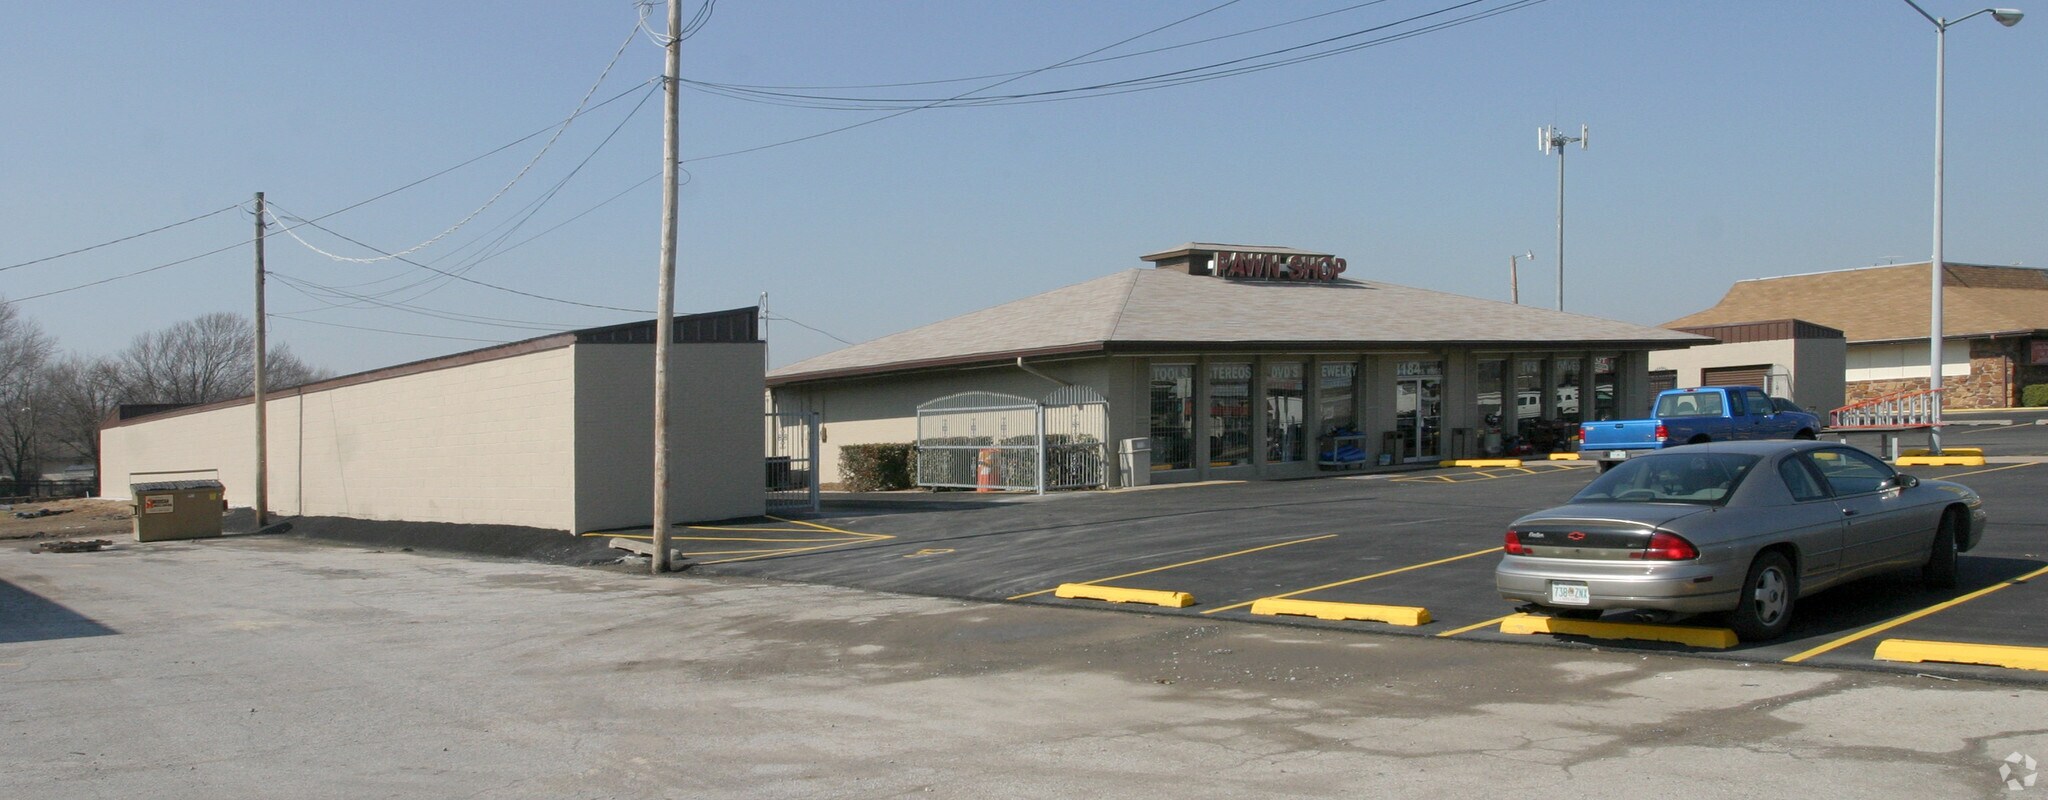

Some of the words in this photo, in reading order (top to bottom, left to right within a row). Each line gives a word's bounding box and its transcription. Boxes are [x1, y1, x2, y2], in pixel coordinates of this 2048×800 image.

[1214, 252, 1281, 278] PAWN
[1286, 255, 1346, 280] SHOP
[1153, 367, 1189, 381] TOOLS
[1321, 364, 1357, 377] EWELRY
